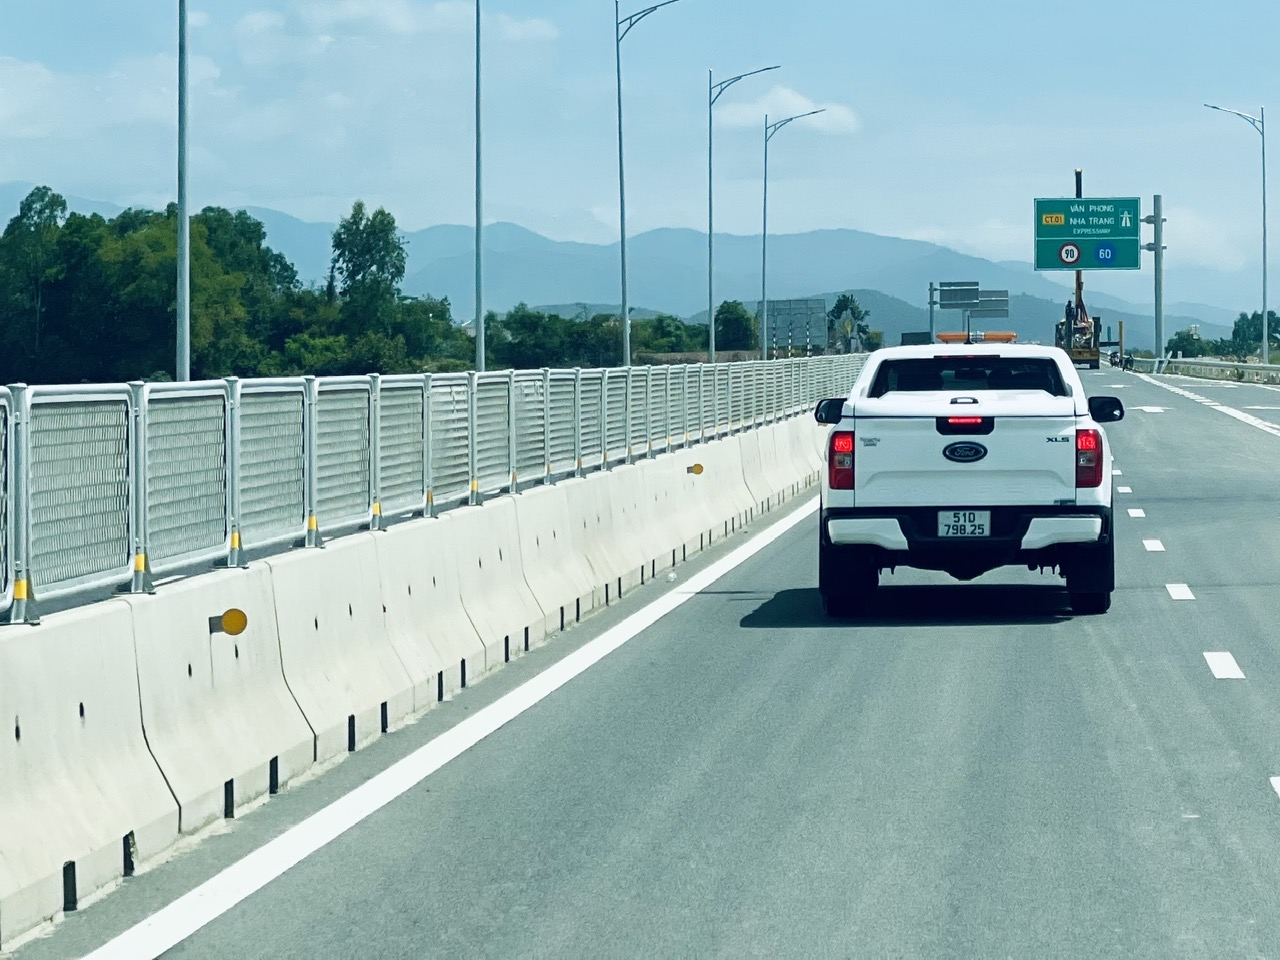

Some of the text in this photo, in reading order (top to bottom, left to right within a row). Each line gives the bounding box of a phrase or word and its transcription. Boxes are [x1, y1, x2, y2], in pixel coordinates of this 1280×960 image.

[1089, 204, 1115, 212] PHONG
[1069, 217, 1115, 225] NHA TRANG
[1064, 248, 1112, 259] 90 60
[953, 512, 976, 524] 51D
[944, 524, 985, 536] 798.25
